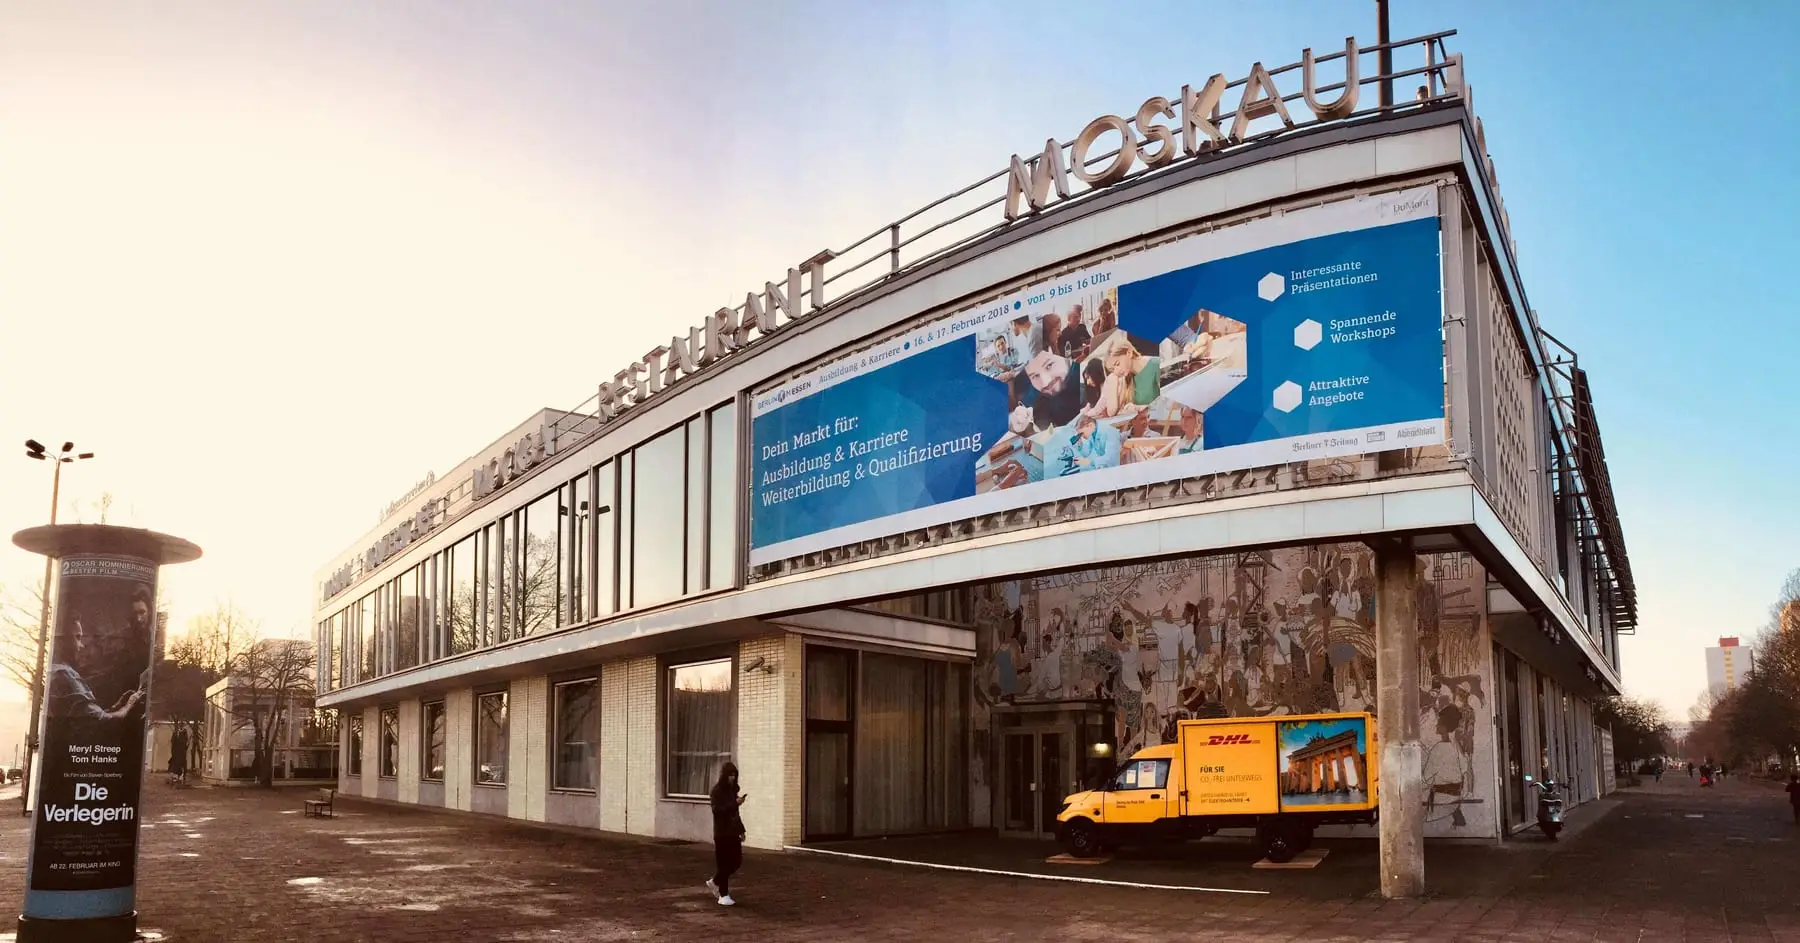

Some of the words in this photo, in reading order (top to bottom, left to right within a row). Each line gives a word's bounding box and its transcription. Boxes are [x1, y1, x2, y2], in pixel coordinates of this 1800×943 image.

[599, 249, 837, 424] RESTAURANT
[1004, 36, 1360, 221] MOSKAU
[1291, 261, 1362, 281] Interessante
[1291, 272, 1378, 295] Präsentationen
[819, 362, 859, 384] Ausbildung
[860, 358, 867, 368] &
[868, 347, 901, 365] Karriere
[914, 336, 925, 347] 16.
[927, 331, 935, 341] &
[937, 327, 950, 340] 17.
[951, 314, 986, 333] Februar
[988, 305, 1010, 320] 2018
[1027, 294, 1045, 306] von
[1049, 289, 1056, 299] 9
[1058, 283, 1073, 296] bis
[1077, 279, 1088, 290] 16
[1091, 271, 1112, 286] Uhr
[1330, 310, 1397, 331] Spannende
[1330, 326, 1397, 344] Workshops
[1308, 374, 1370, 391] Attraktive
[1308, 389, 1365, 407] Angebote
[761, 441, 789, 461] Dein
[793, 425, 831, 448] Markt
[834, 415, 859, 436] für:
[761, 452, 831, 486] Ausbildung
[834, 446, 845, 463] &
[848, 428, 909, 459] Karriere
[761, 468, 850, 507] Weiterbildung
[854, 463, 865, 480] &
[868, 432, 983, 477] Qualifizierung
[63, 561, 70, 576] 2
[70, 560, 96, 568] OSCAR
[99, 568, 118, 576] FILM
[69, 744, 93, 754] Meryl
[94, 744, 122, 754] Streep
[1207, 734, 1252, 746] DHL
[71, 755, 89, 763] Tom
[91, 755, 118, 763] Hanks
[1199, 764, 1213, 773] FÜR
[1214, 765, 1225, 773] SIE
[75, 782, 109, 800] Die
[44, 803, 134, 826] Verlegerin
[68, 862, 98, 870] FEBRUAR
